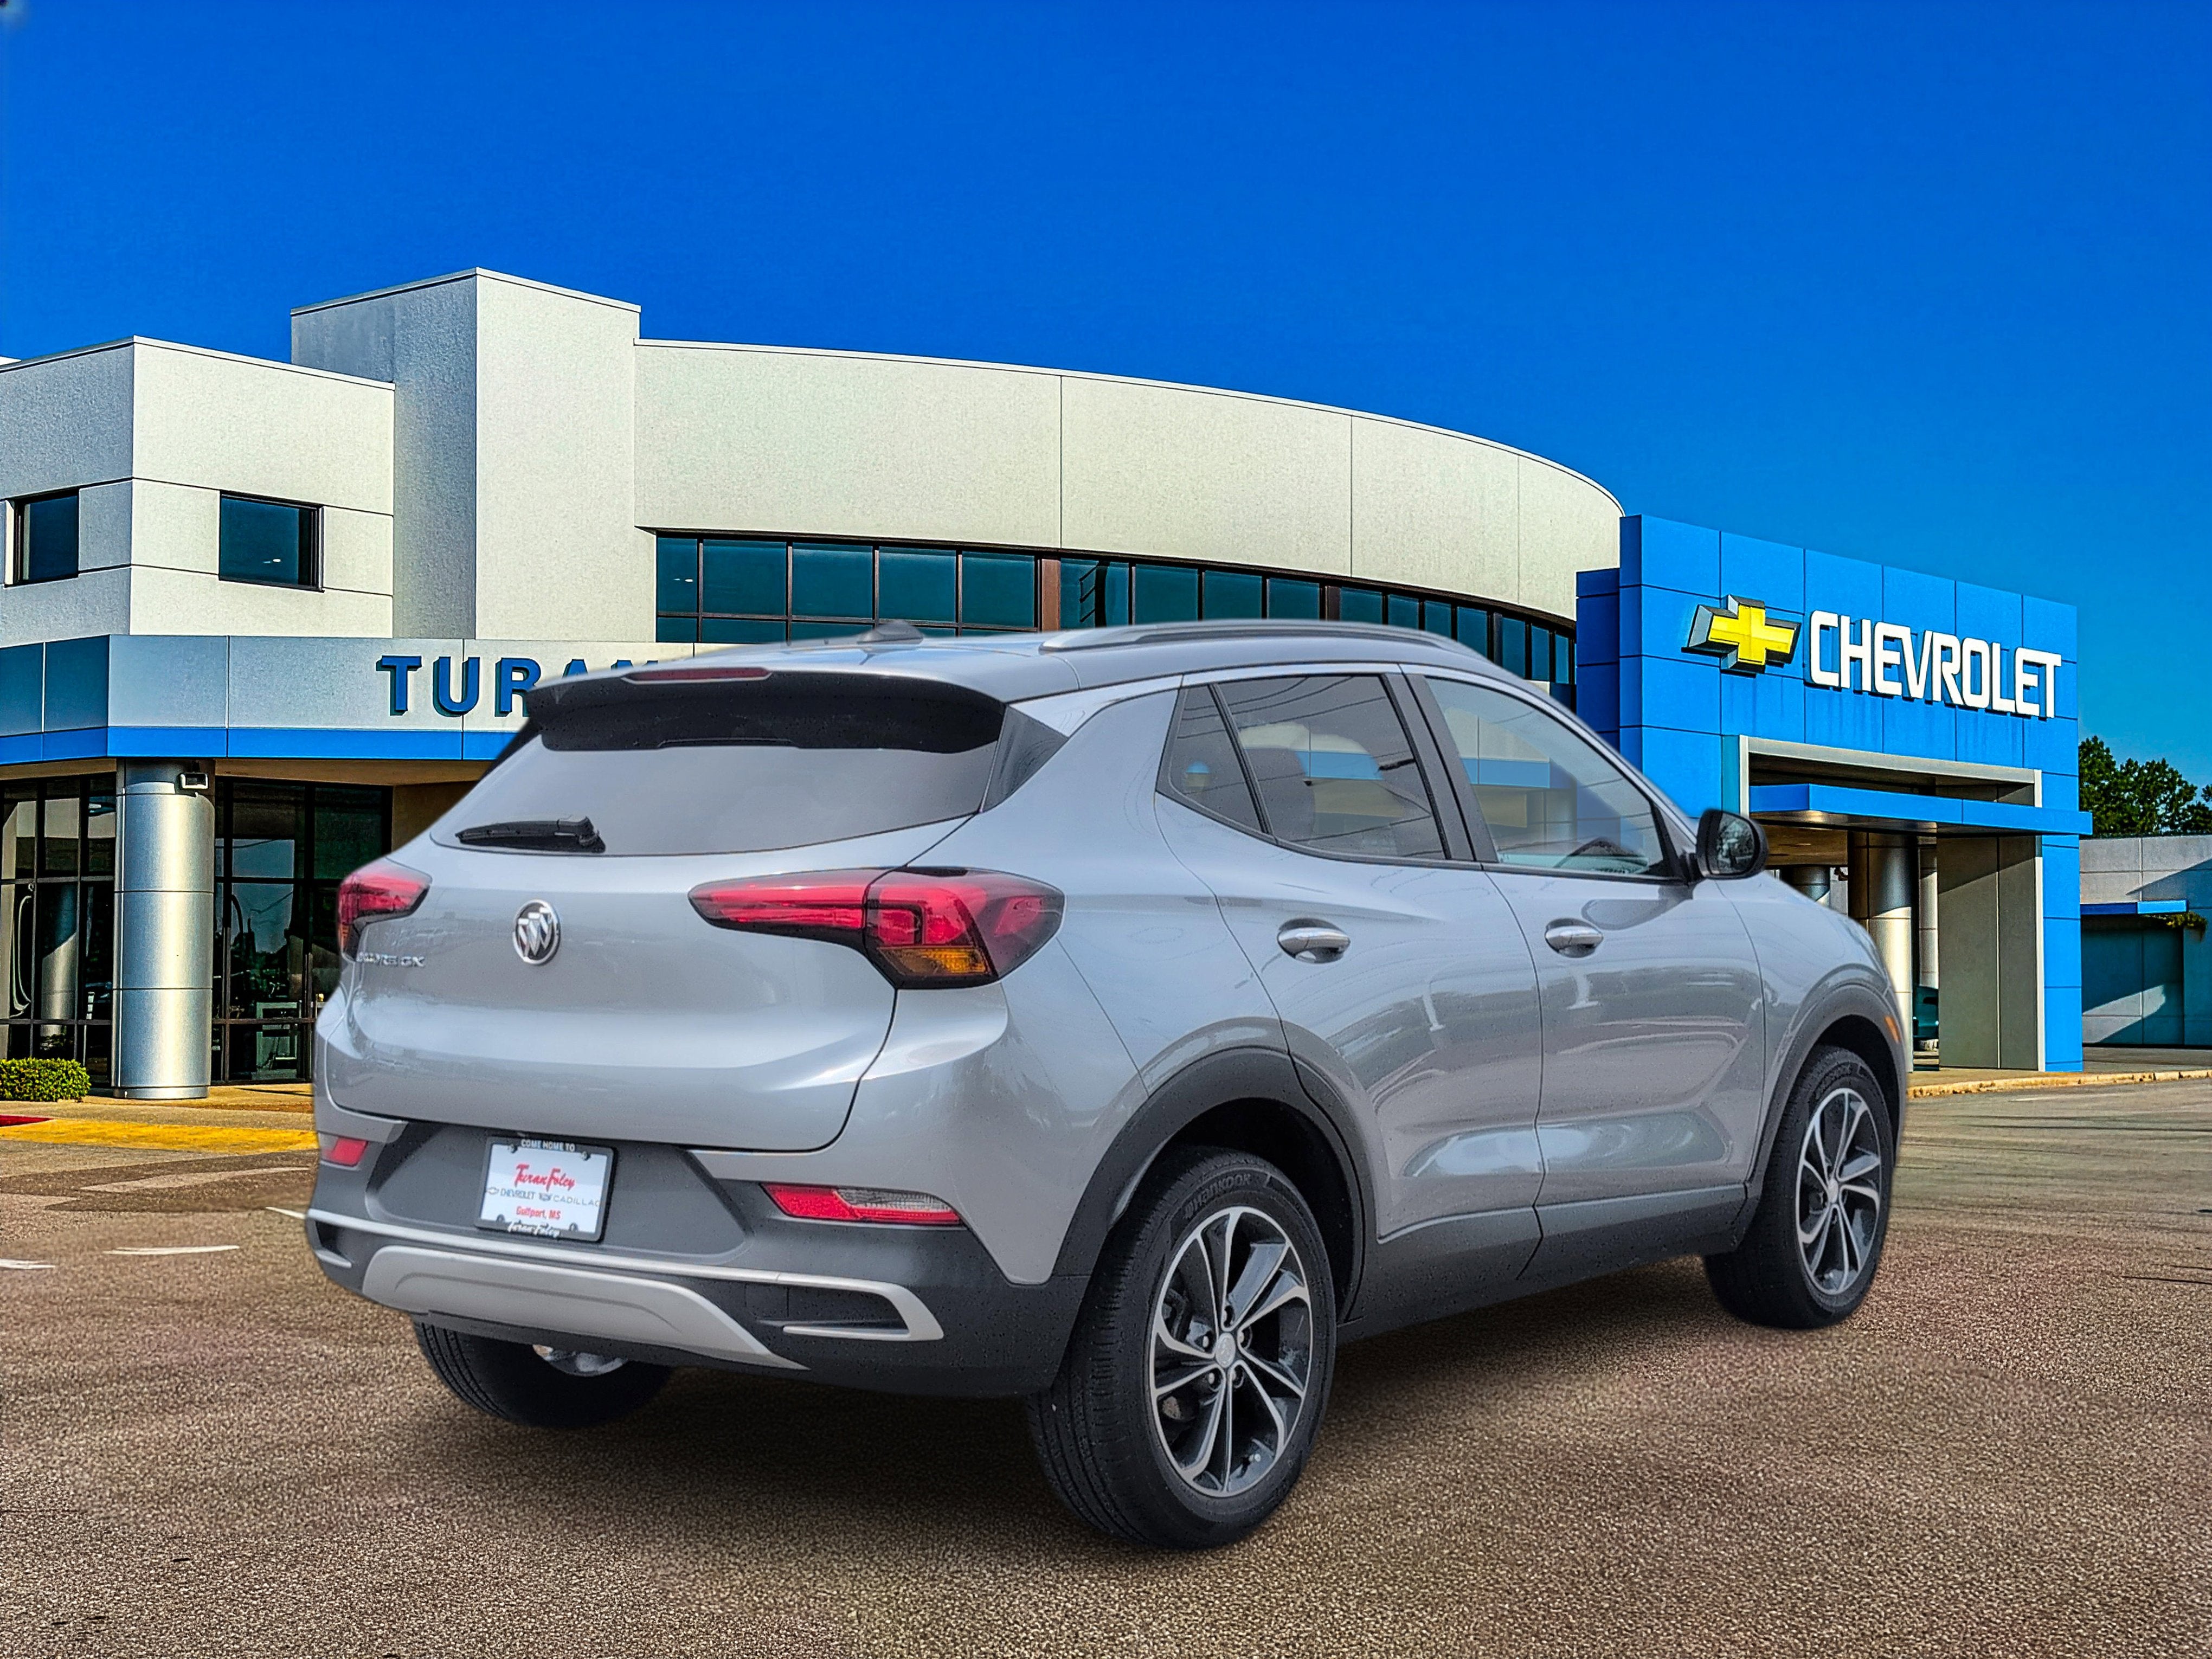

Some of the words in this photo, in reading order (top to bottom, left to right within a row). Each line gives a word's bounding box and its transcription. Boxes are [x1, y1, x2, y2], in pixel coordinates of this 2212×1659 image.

[1808, 610, 2062, 719] CHEVROLET
[376, 654, 659, 718] TUR
[565, 1143, 575, 1152] TO
[552, 1195, 601, 1207] CADILLAC
[549, 1209, 562, 1220] MS
